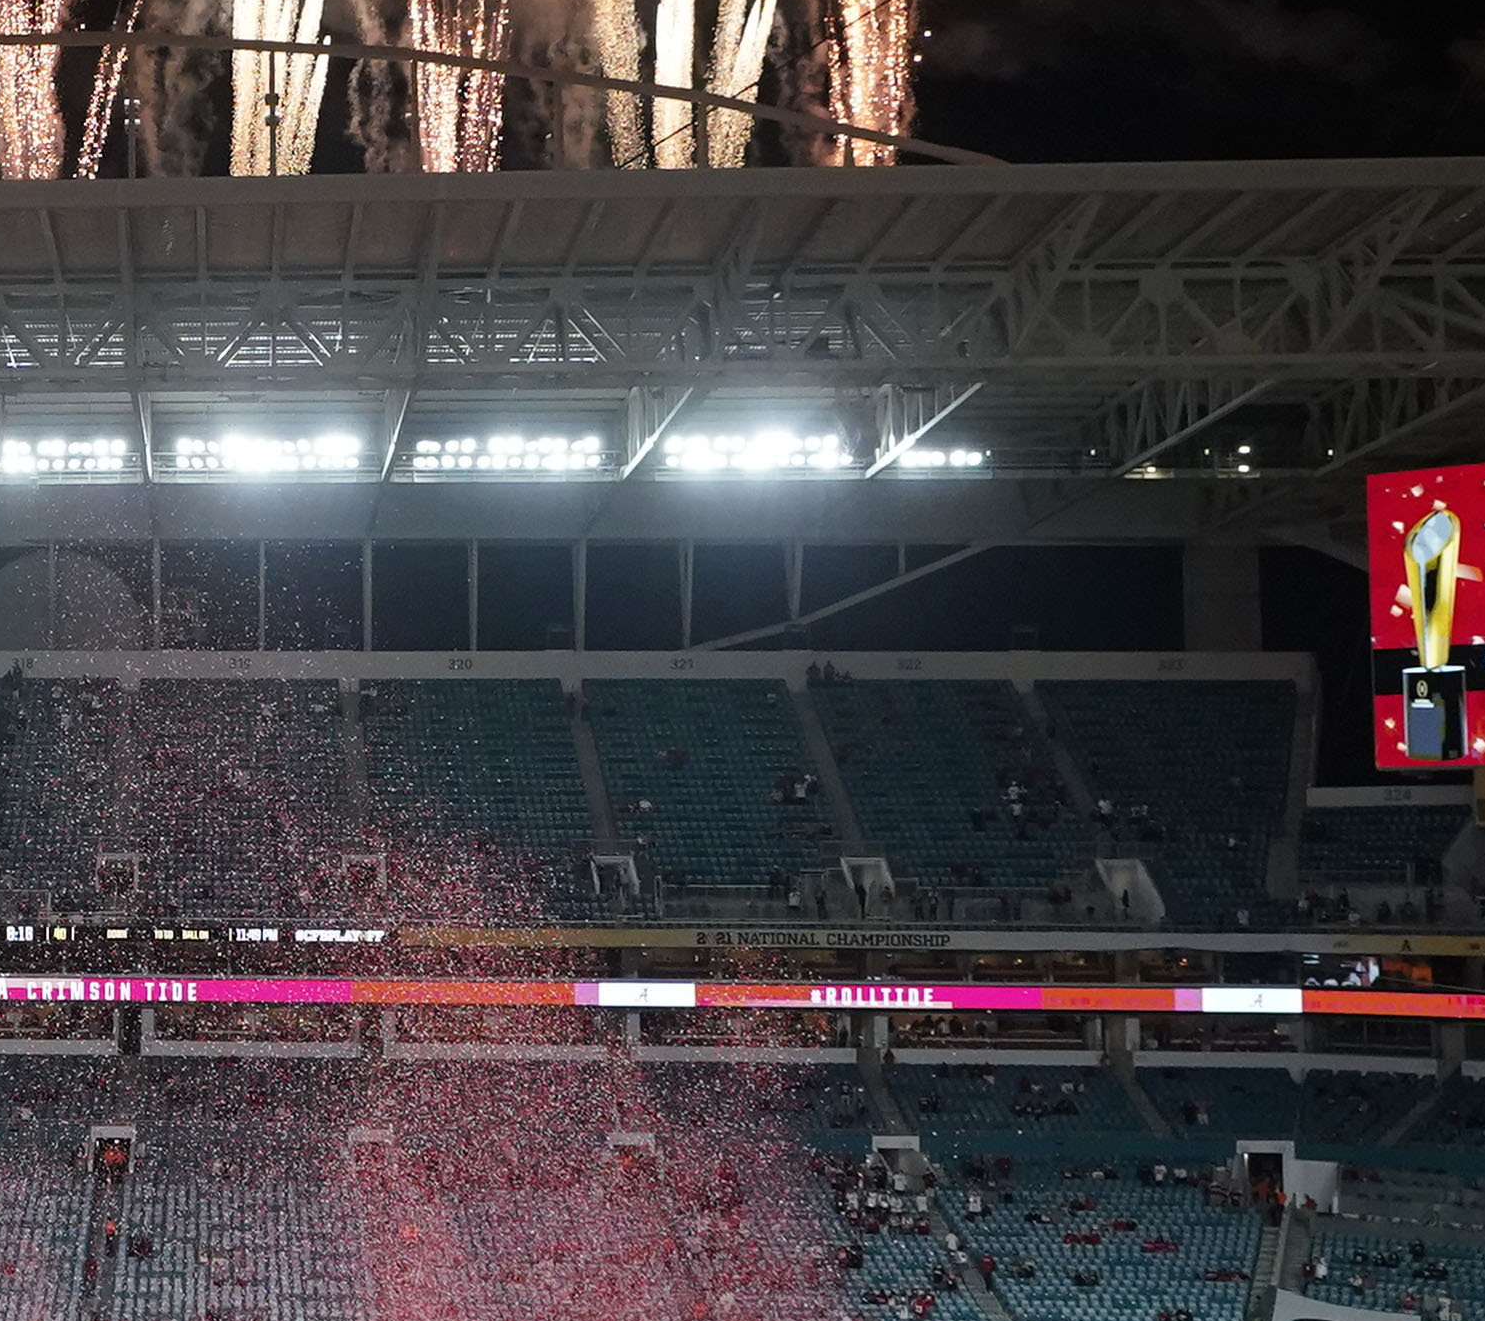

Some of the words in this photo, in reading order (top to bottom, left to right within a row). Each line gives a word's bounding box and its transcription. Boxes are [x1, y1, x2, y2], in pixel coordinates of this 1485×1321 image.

[262, 928, 278, 941] PM
[737, 932, 821, 946] NATIONAL
[826, 933, 951, 948] CHAMPIONSHIP
[26, 980, 133, 1003] CRIMSON
[144, 981, 199, 1003] TIDE
[810, 987, 935, 1008] #ROLLTIDE
